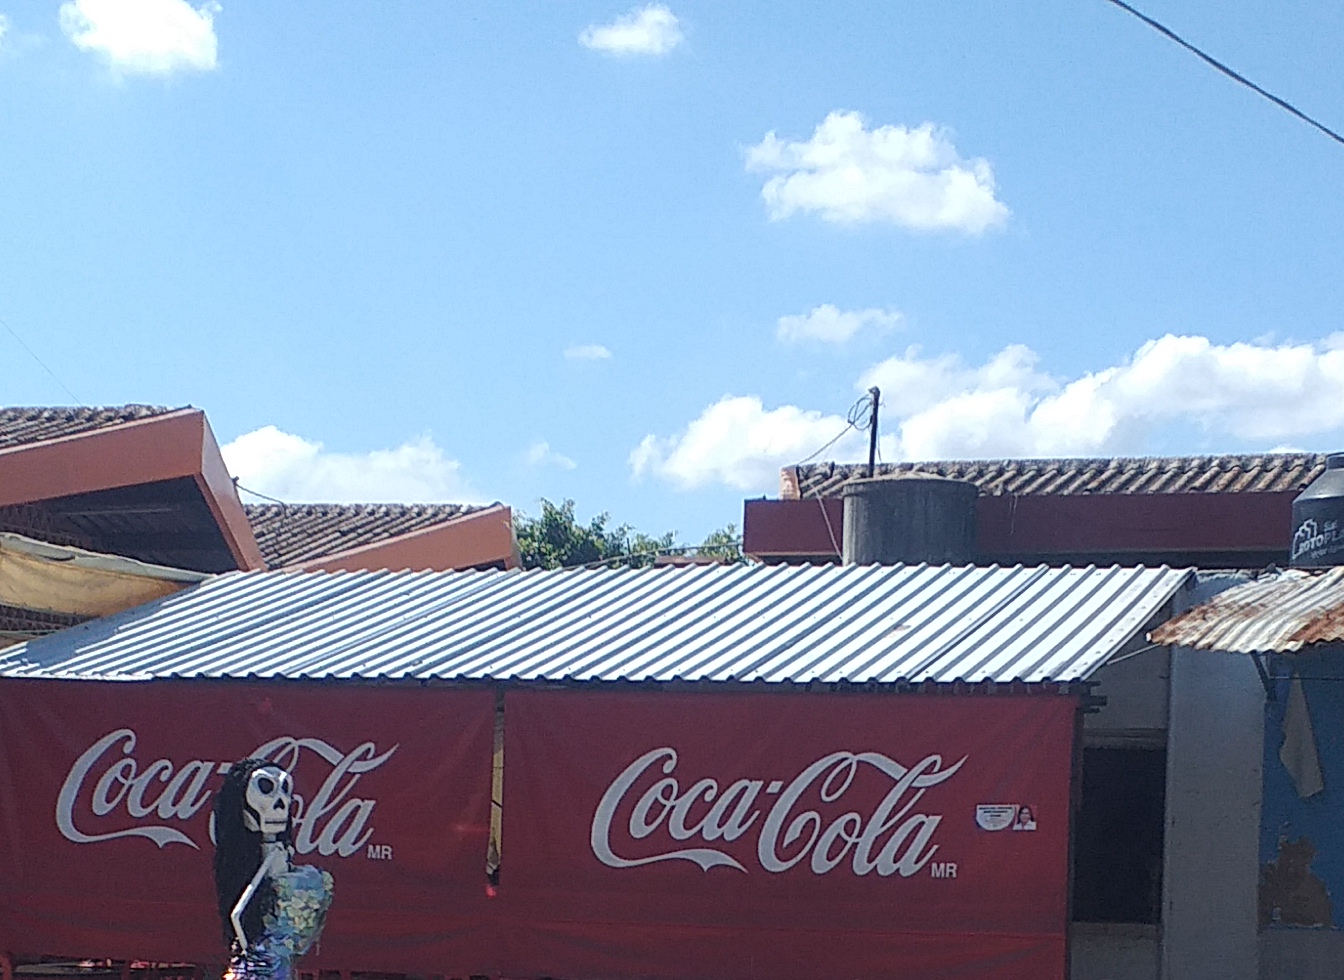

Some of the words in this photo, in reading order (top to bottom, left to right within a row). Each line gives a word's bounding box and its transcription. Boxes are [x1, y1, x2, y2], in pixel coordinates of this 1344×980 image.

[591, 747, 968, 876] Coca-Cola
[367, 845, 393, 860] MR
[931, 862, 958, 878] MR
